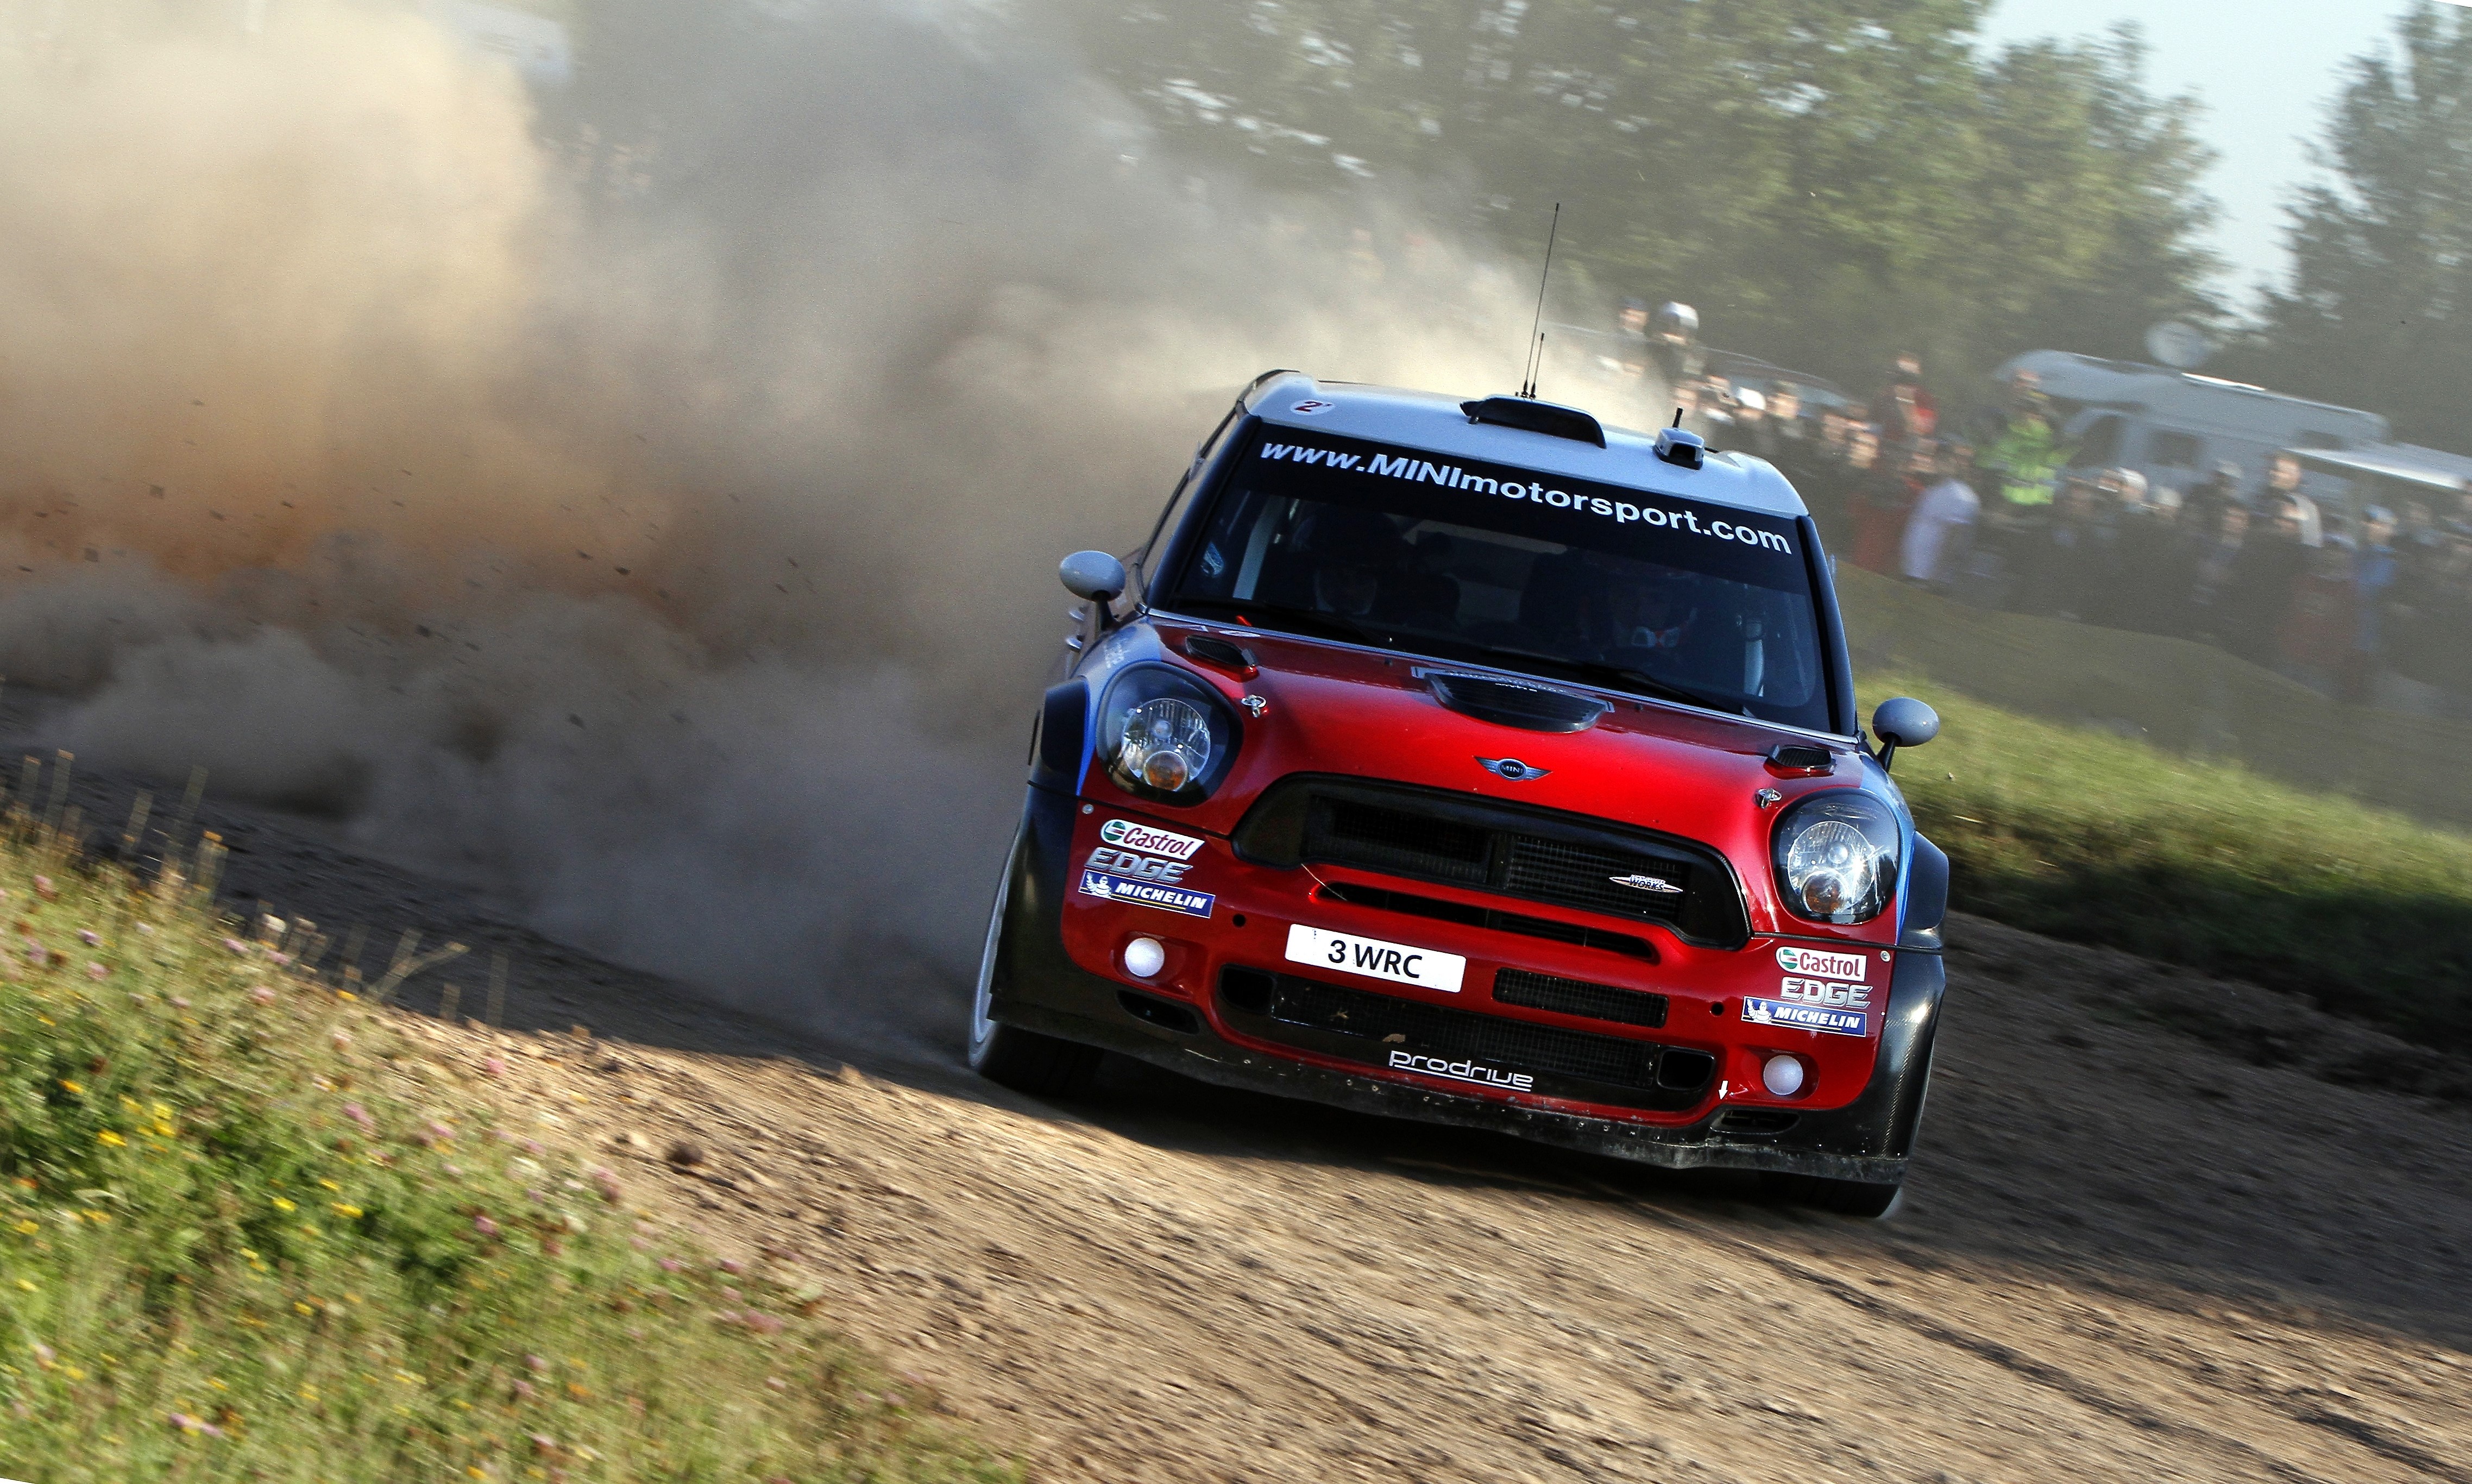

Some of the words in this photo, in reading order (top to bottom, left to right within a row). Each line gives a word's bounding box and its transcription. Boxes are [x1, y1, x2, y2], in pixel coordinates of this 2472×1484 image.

[1260, 443, 1791, 555] www.MINImotorsport.com
[1123, 826, 1194, 856] Castrol
[1085, 847, 1193, 883] EDGE
[1115, 883, 1206, 909] MICHELIN
[1630, 877, 1664, 890] WORKS
[1328, 940, 1345, 964] 3
[1355, 944, 1422, 978] WRC
[1799, 952, 1860, 977] Castrol
[1781, 977, 1873, 1009] EDGE
[1773, 1005, 1859, 1029] MICHELIN
[1389, 1050, 1534, 1086] prodrive
